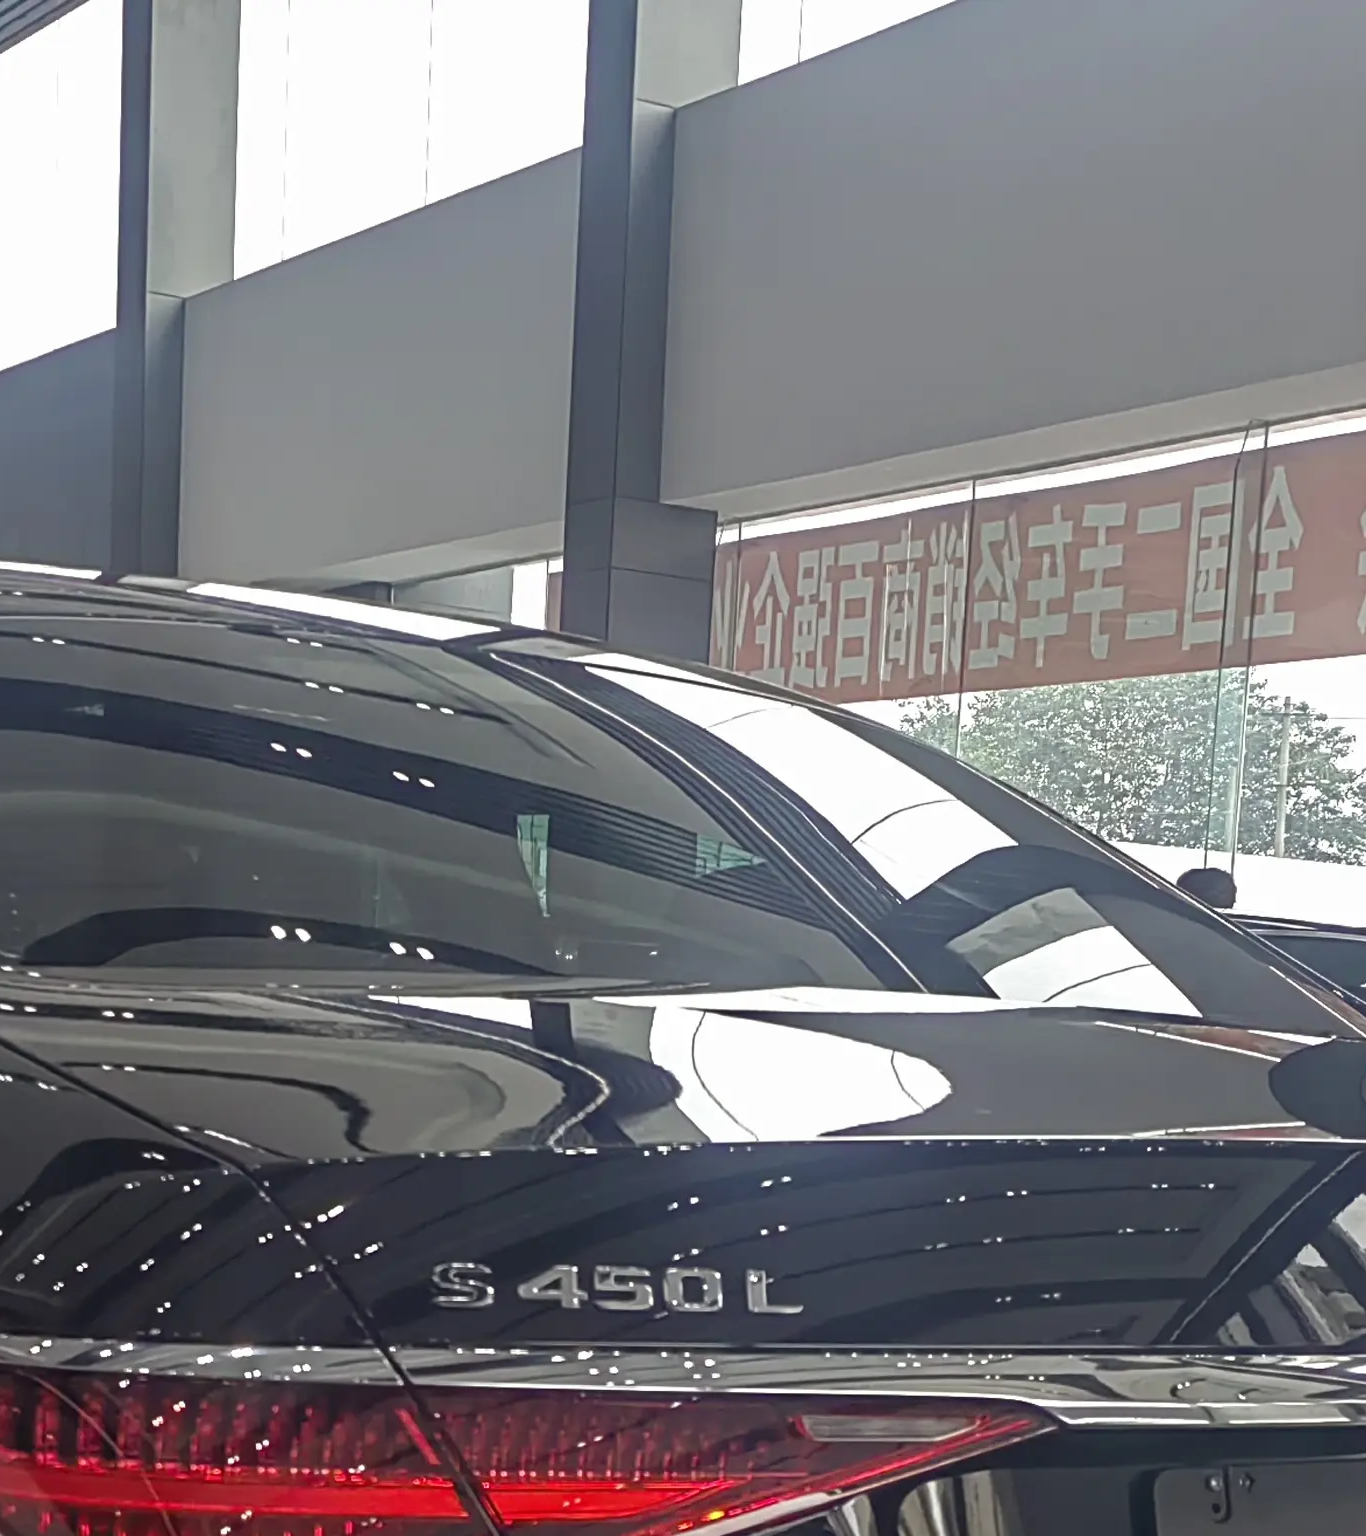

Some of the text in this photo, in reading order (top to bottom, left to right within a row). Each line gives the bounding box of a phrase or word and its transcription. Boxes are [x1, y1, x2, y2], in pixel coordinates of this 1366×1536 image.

[432, 1262, 804, 1314] S 450 L
